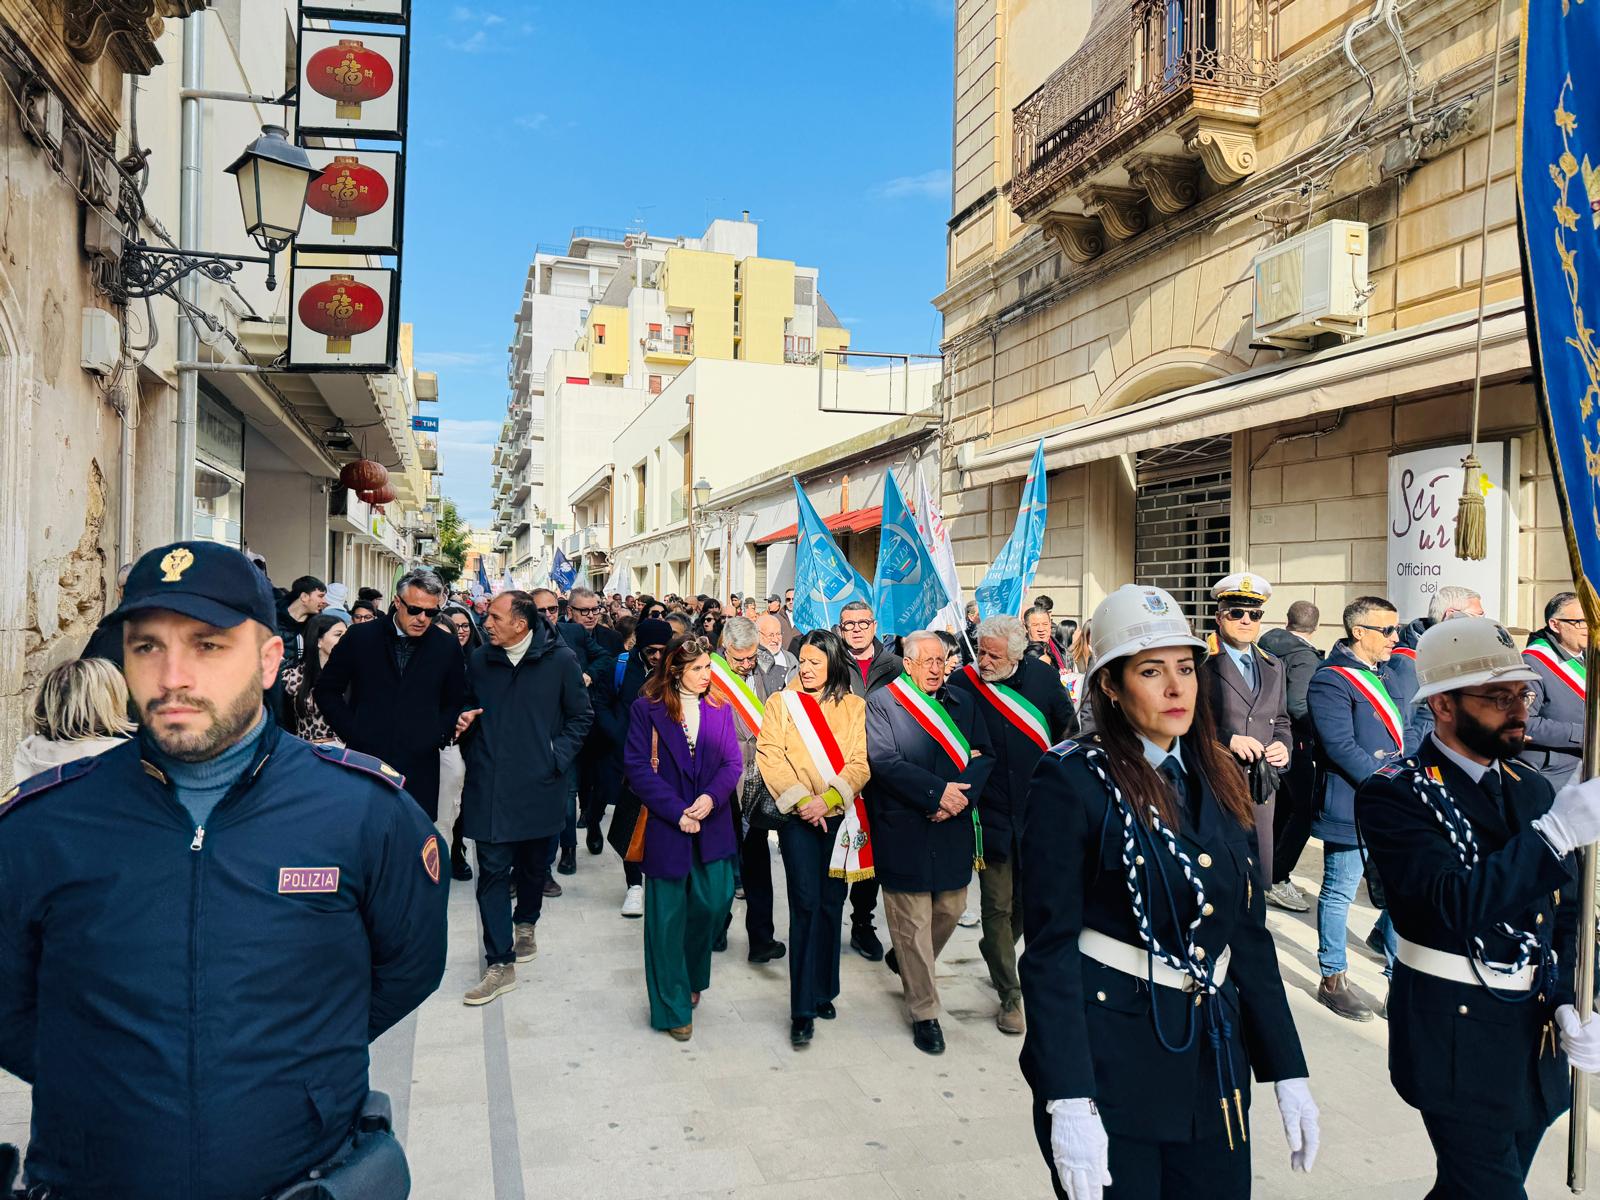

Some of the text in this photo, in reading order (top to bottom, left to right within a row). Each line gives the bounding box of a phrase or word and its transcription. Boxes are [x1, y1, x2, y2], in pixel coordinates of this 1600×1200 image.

[422, 420, 436, 428] TIM
[1397, 562, 1441, 577] Officina
[1420, 581, 1438, 594] dei
[283, 873, 334, 887] POLIZIA
